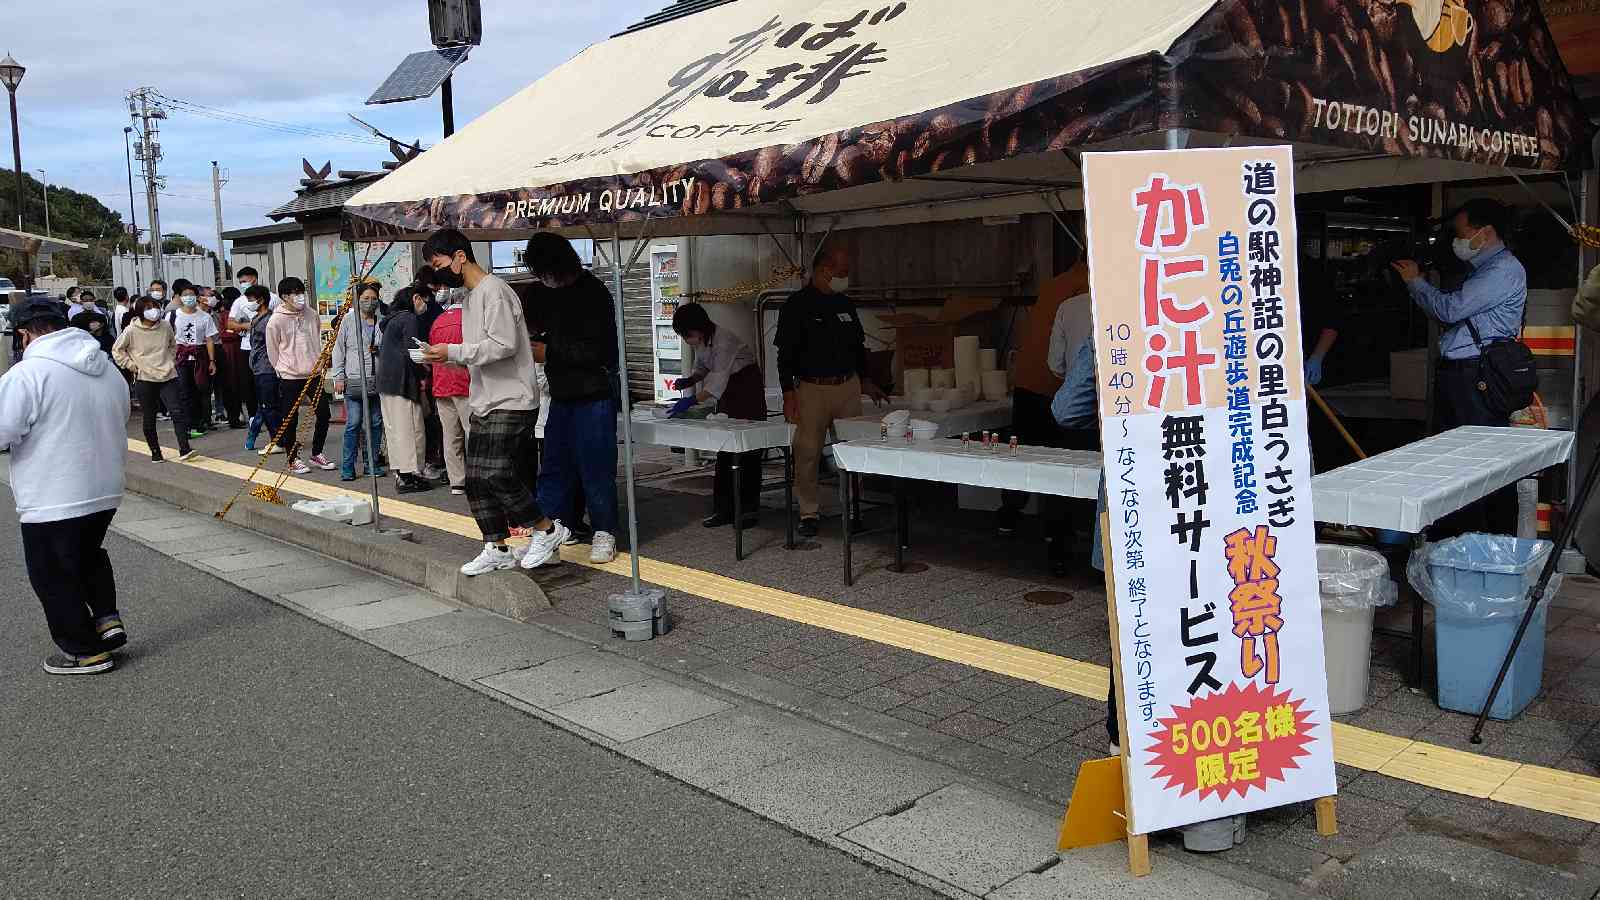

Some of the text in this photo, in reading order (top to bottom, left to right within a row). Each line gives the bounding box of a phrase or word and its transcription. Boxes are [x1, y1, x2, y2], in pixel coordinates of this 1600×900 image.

[645, 118, 802, 140] COFFEE
[1313, 98, 1541, 158] TOTTORI SUNABA COFFEE
[503, 177, 696, 220] PREMIUM QUALITY
[1218, 230, 1259, 515] 白兎の丘遊歩道完成記念
[1243, 162, 1295, 528] 道の駅神話の里白うさぎ
[1135, 176, 1224, 696] かに汁 無料サービス
[1115, 446, 1145, 570] なくなり次第
[1127, 576, 1159, 728] 終了となります。
[1223, 524, 1285, 685] 秋祭り
[1171, 703, 1298, 756] 500名様
[1195, 747, 1261, 790] 限定
